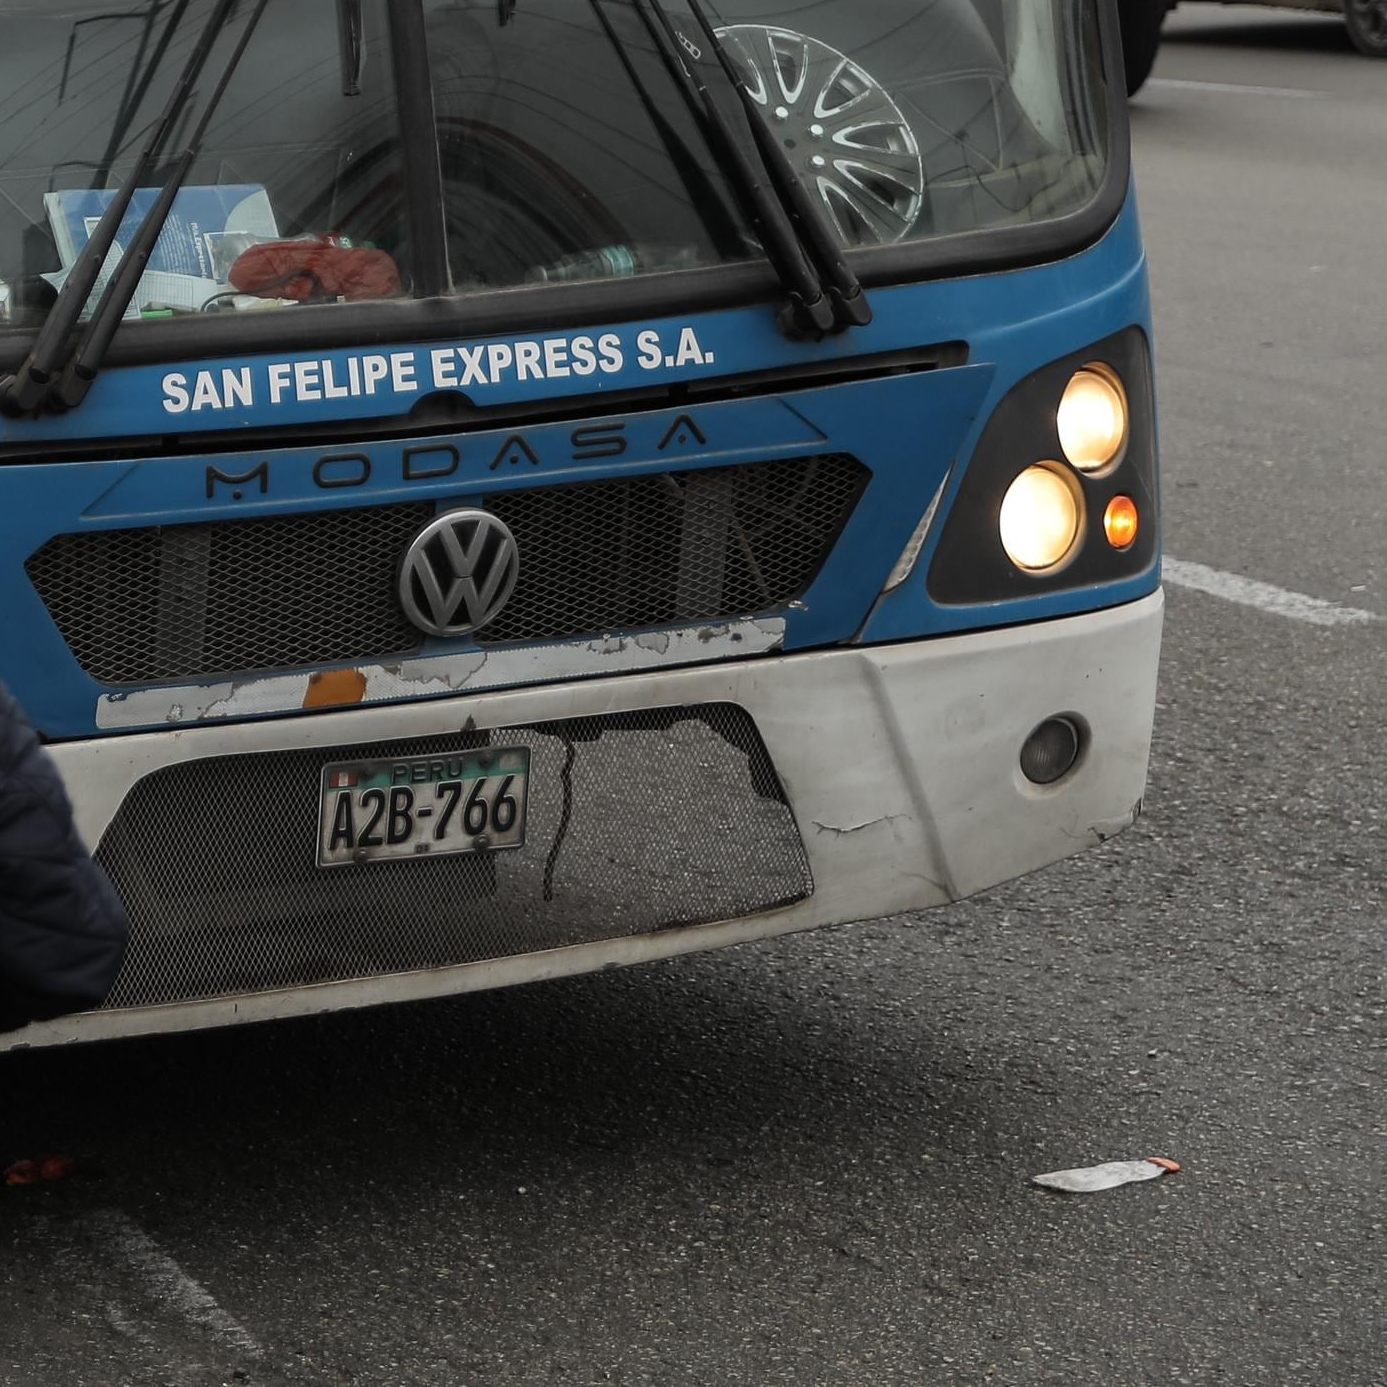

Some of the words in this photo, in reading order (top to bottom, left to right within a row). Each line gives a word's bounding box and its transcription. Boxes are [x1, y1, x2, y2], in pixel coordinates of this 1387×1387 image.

[162, 367, 254, 414] SAN
[269, 351, 417, 405] FELIPE
[431, 330, 625, 388] EXPRESS
[636, 327, 715, 370] S.A.
[205, 414, 707, 501] MODASA
[329, 774, 516, 851] A2B-766
[391, 759, 465, 785] PERU
